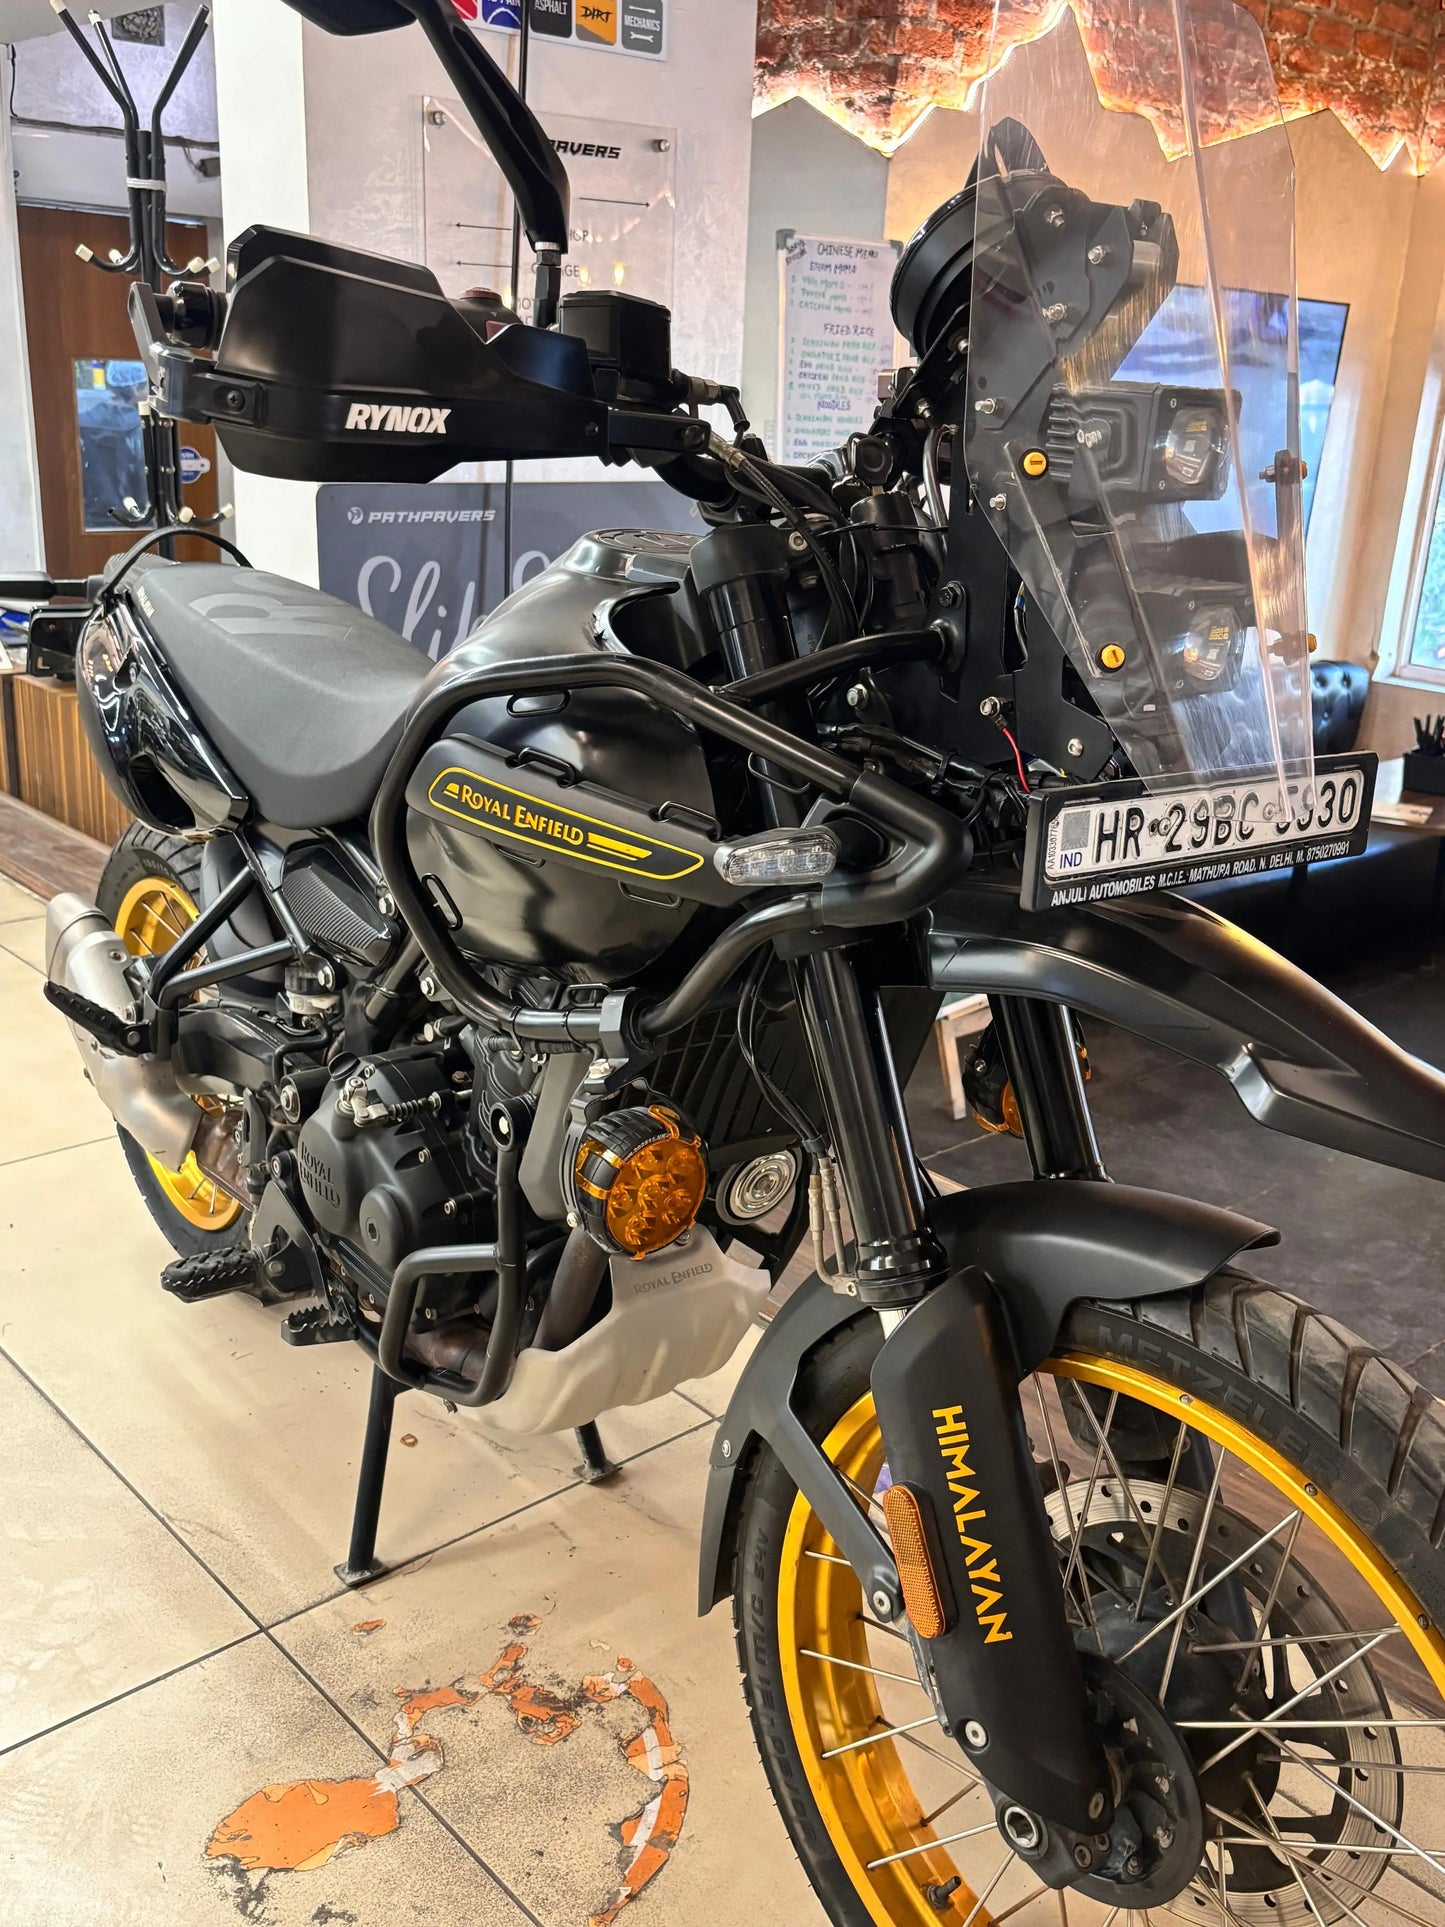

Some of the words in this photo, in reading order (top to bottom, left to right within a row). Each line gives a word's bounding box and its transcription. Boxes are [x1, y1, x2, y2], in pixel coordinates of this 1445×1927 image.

[534, 0, 567, 15] ASPHALT
[581, 6, 612, 23] DIRT
[624, 14, 661, 31] MECHANICS
[817, 243, 853, 258] CHINESE
[345, 403, 452, 434] RYNOX
[367, 510, 496, 524] PATHPAVERS
[461, 785, 511, 820] ROYAL
[513, 805, 584, 846] ENFIELD
[1094, 807, 1142, 864] HR
[1051, 888, 1087, 907] ANJULI
[1088, 875, 1155, 901] AUTOMOBILES
[1188, 861, 1231, 883] MATHURA
[1306, 840, 1350, 862] 8750270991
[1060, 852, 1083, 869] IND
[301, 1141, 333, 1184] ROYAL
[300, 1161, 341, 1209] ENFIELD
[633, 1276, 671, 1296] ROYAL
[671, 1262, 714, 1285] ENFIELD
[1098, 1325, 1340, 1487] METZELER
[932, 1404, 1014, 1644] HIMALAYAN
